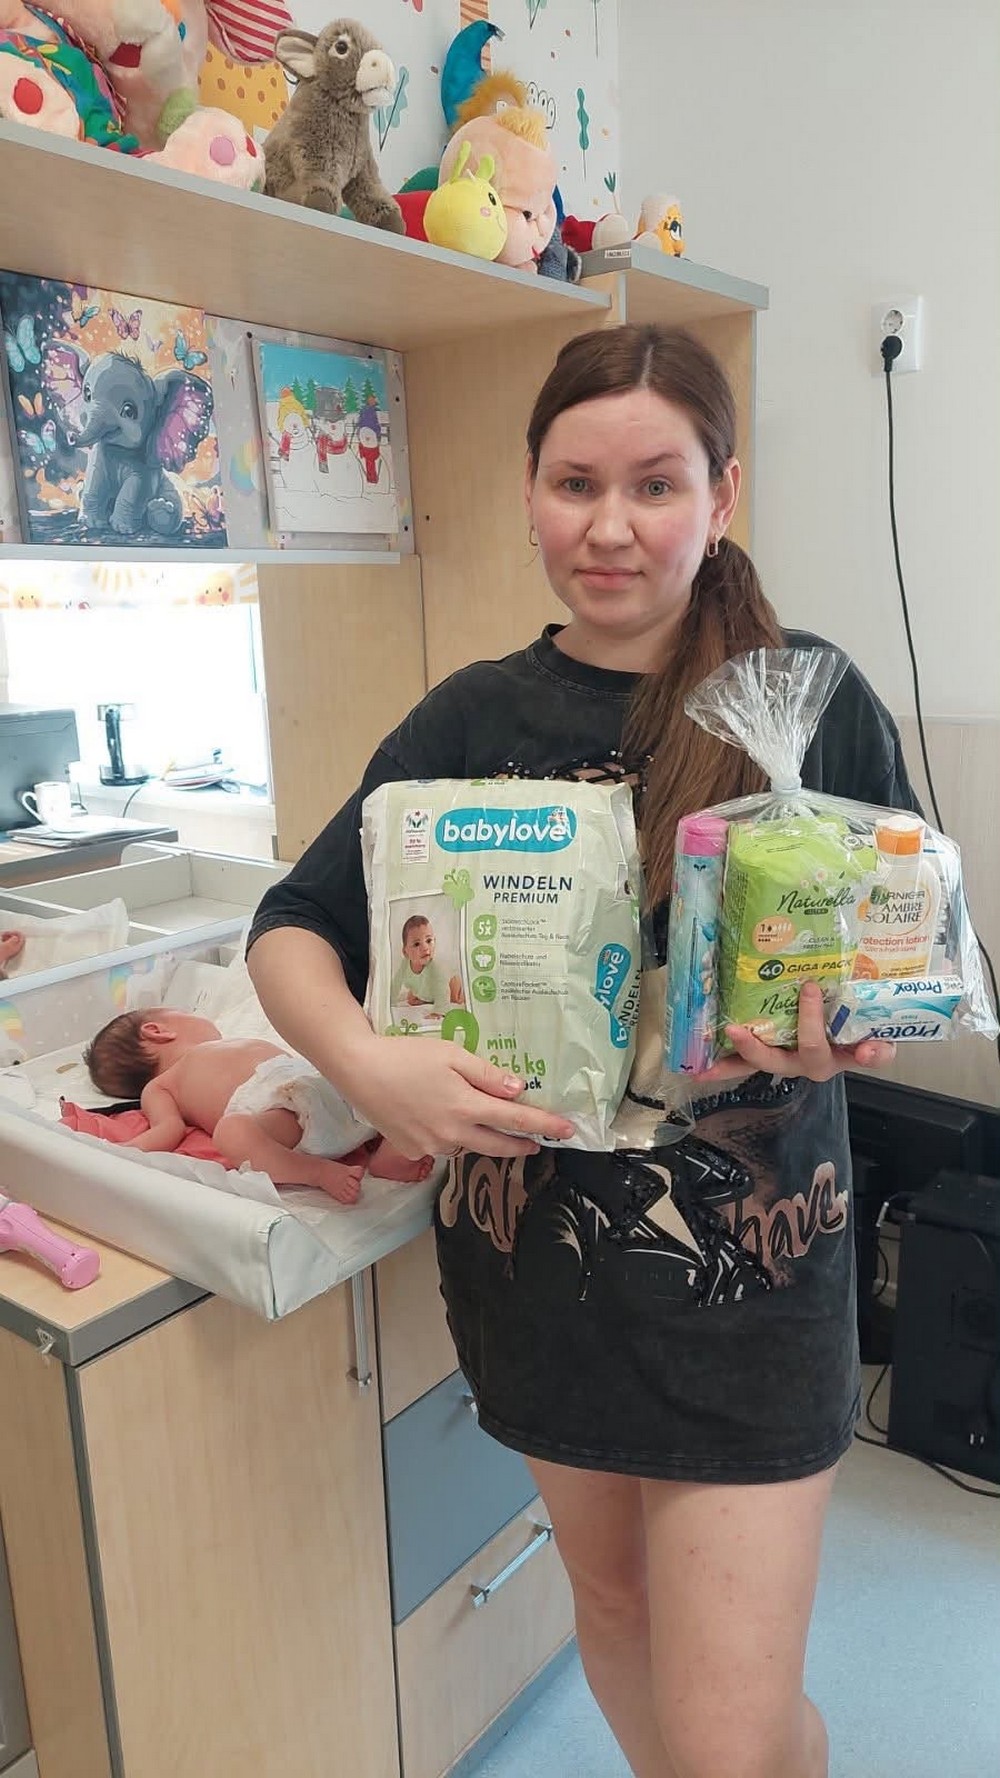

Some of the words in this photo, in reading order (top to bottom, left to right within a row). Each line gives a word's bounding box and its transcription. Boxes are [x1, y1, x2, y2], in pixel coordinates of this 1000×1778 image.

[443, 818, 566, 847] babylove
[483, 875, 572, 891] WINDELN
[494, 892, 559, 904] PREMIUM
[777, 887, 857, 914] Naturella
[882, 901, 924, 913] AMBRE
[864, 911, 922, 924] SOLAIRE
[759, 964, 783, 976] 40
[787, 964, 818, 973] GIGA
[821, 958, 853, 970] PACK
[892, 980, 942, 997] Protex
[864, 1023, 940, 1040] Protex
[487, 1033, 517, 1050] mini
[524, 1052, 546, 1076] kg
